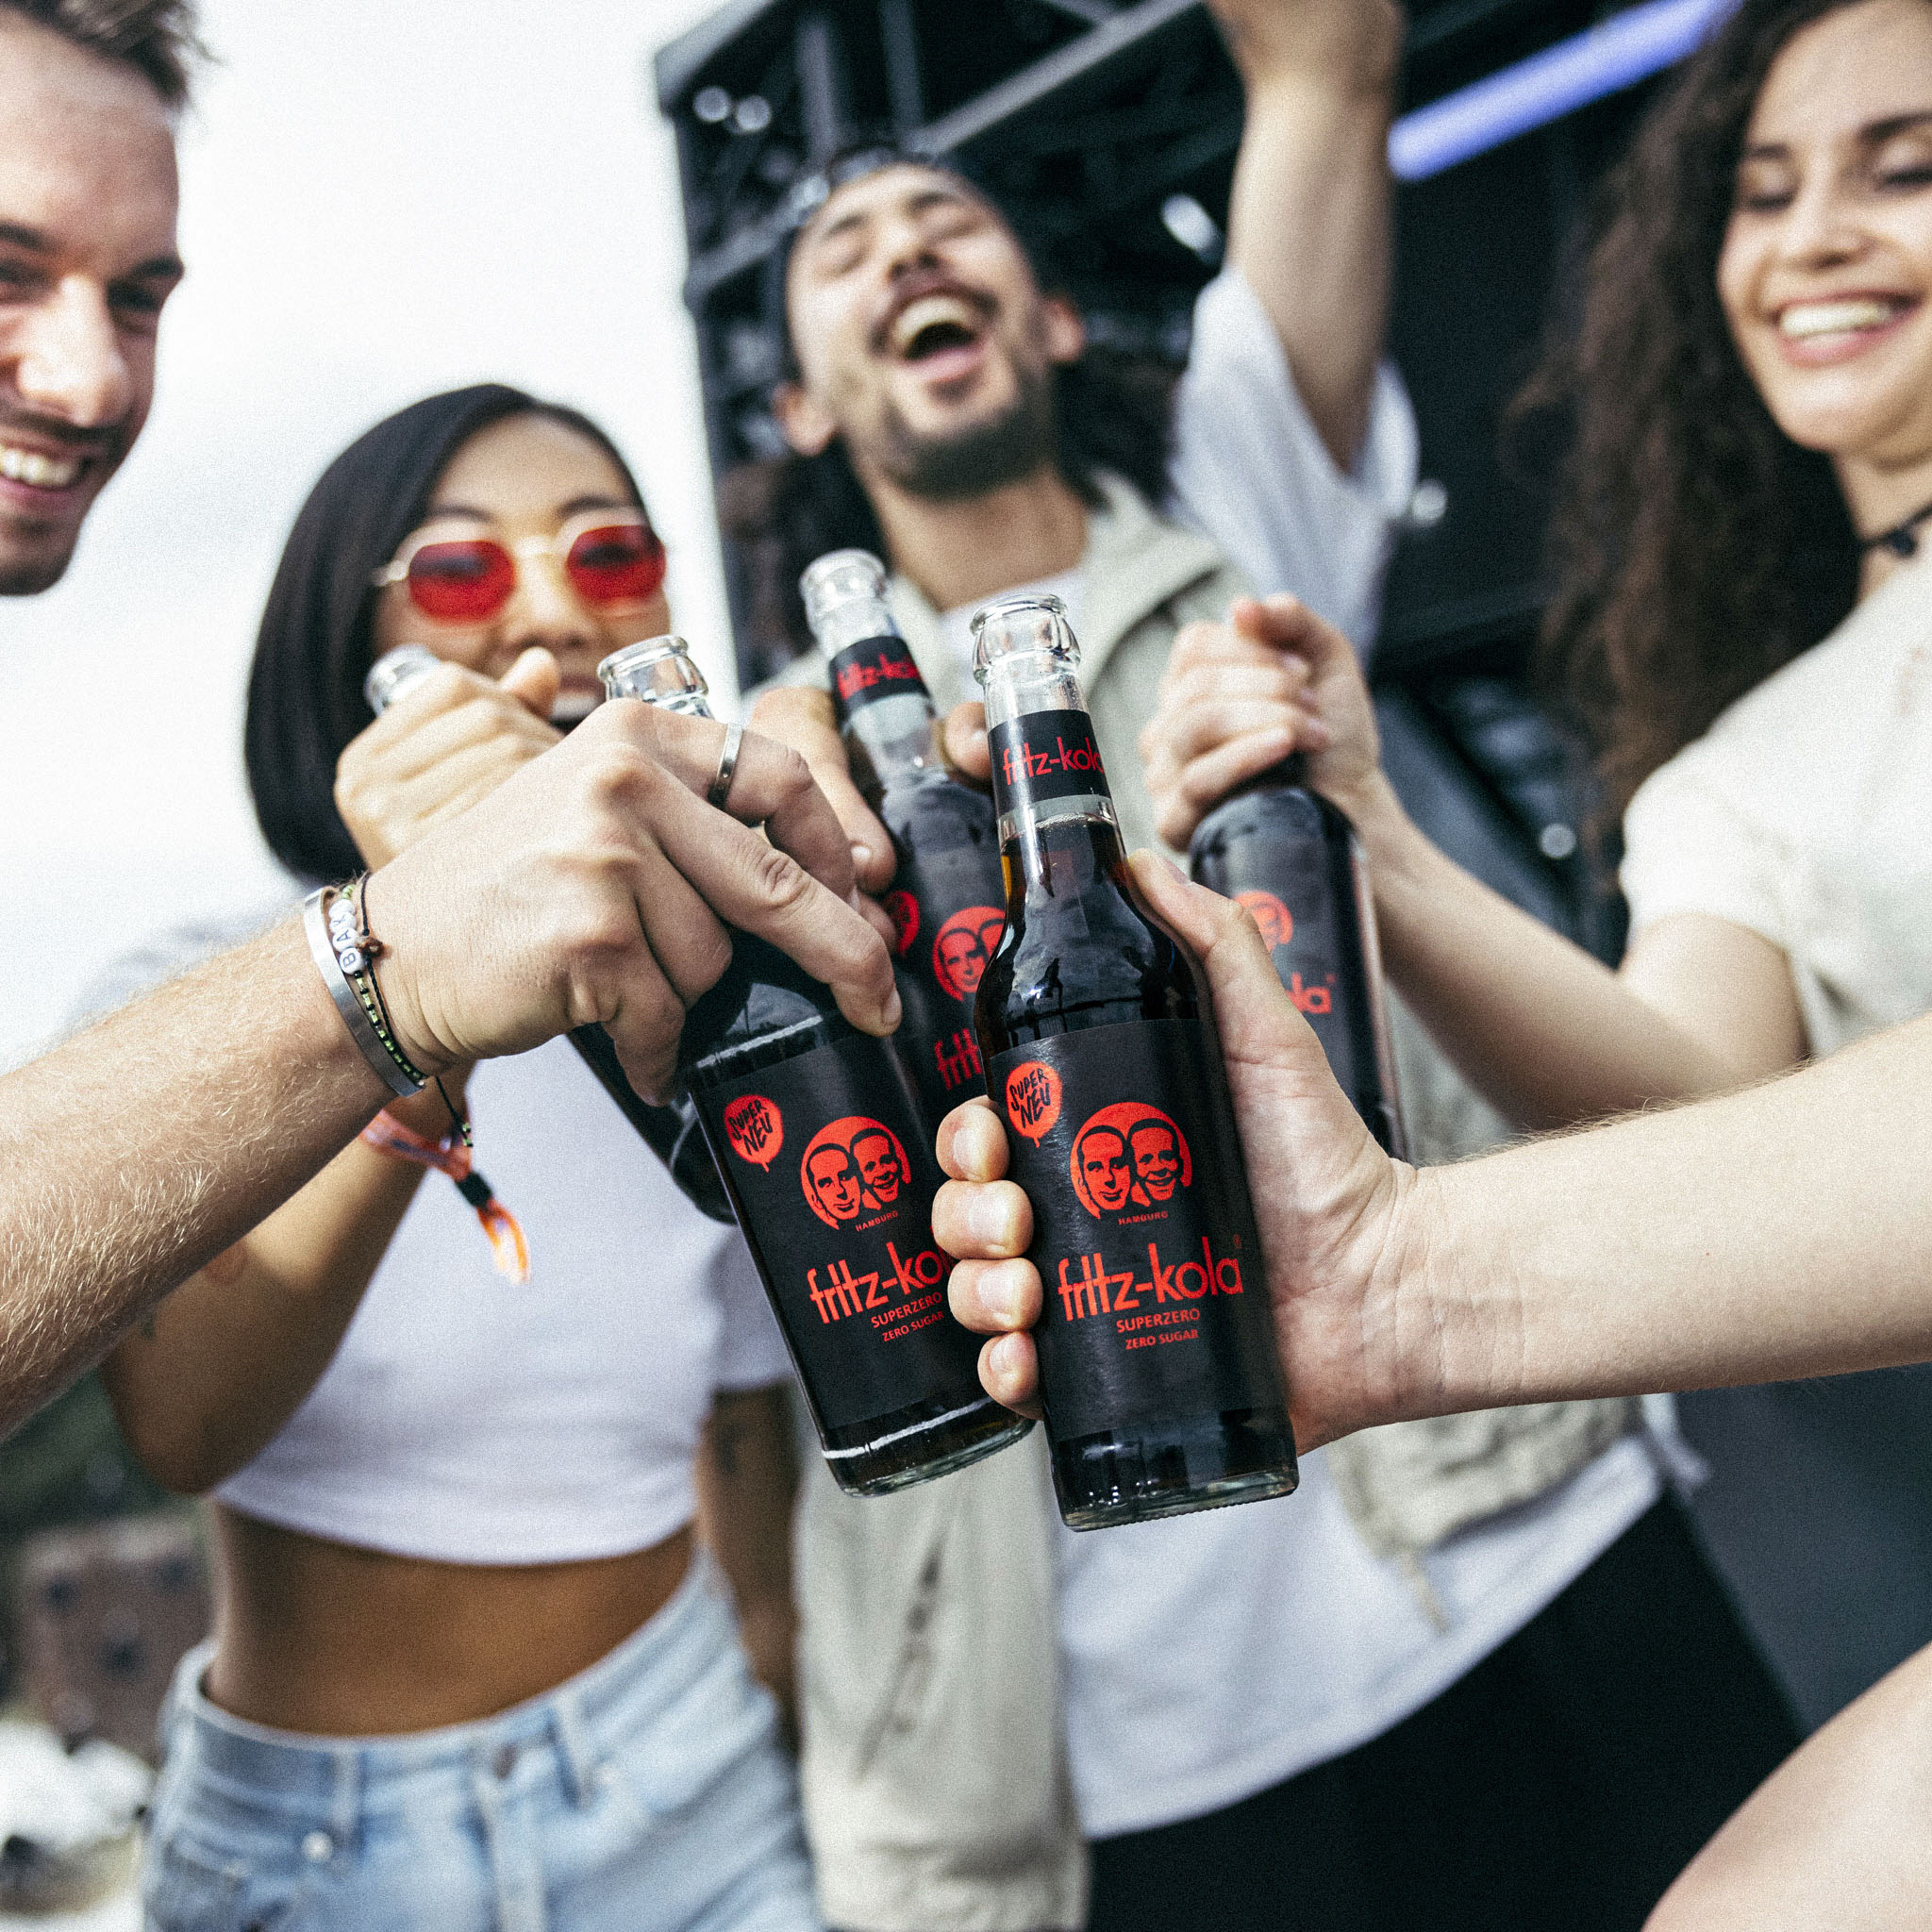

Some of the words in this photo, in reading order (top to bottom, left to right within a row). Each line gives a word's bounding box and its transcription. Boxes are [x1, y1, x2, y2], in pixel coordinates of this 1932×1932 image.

[1009, 1068, 1049, 1111] SUPER
[1021, 1083, 1051, 1129] NEU
[728, 1100, 769, 1141] SUPER
[742, 1112, 773, 1157] NEU
[855, 1210, 899, 1232] HAMBURG
[1118, 1210, 1169, 1225] HAMBURG
[1058, 1236, 1244, 1322] fritz-kola
[871, 1291, 942, 1329] SUPERZERO
[882, 1324, 909, 1342] ZERO
[910, 1310, 944, 1332] SUGAR
[1116, 1307, 1201, 1333] SUPERZERO
[1125, 1335, 1156, 1350] ZERO
[1158, 1328, 1199, 1345] SUGAR
